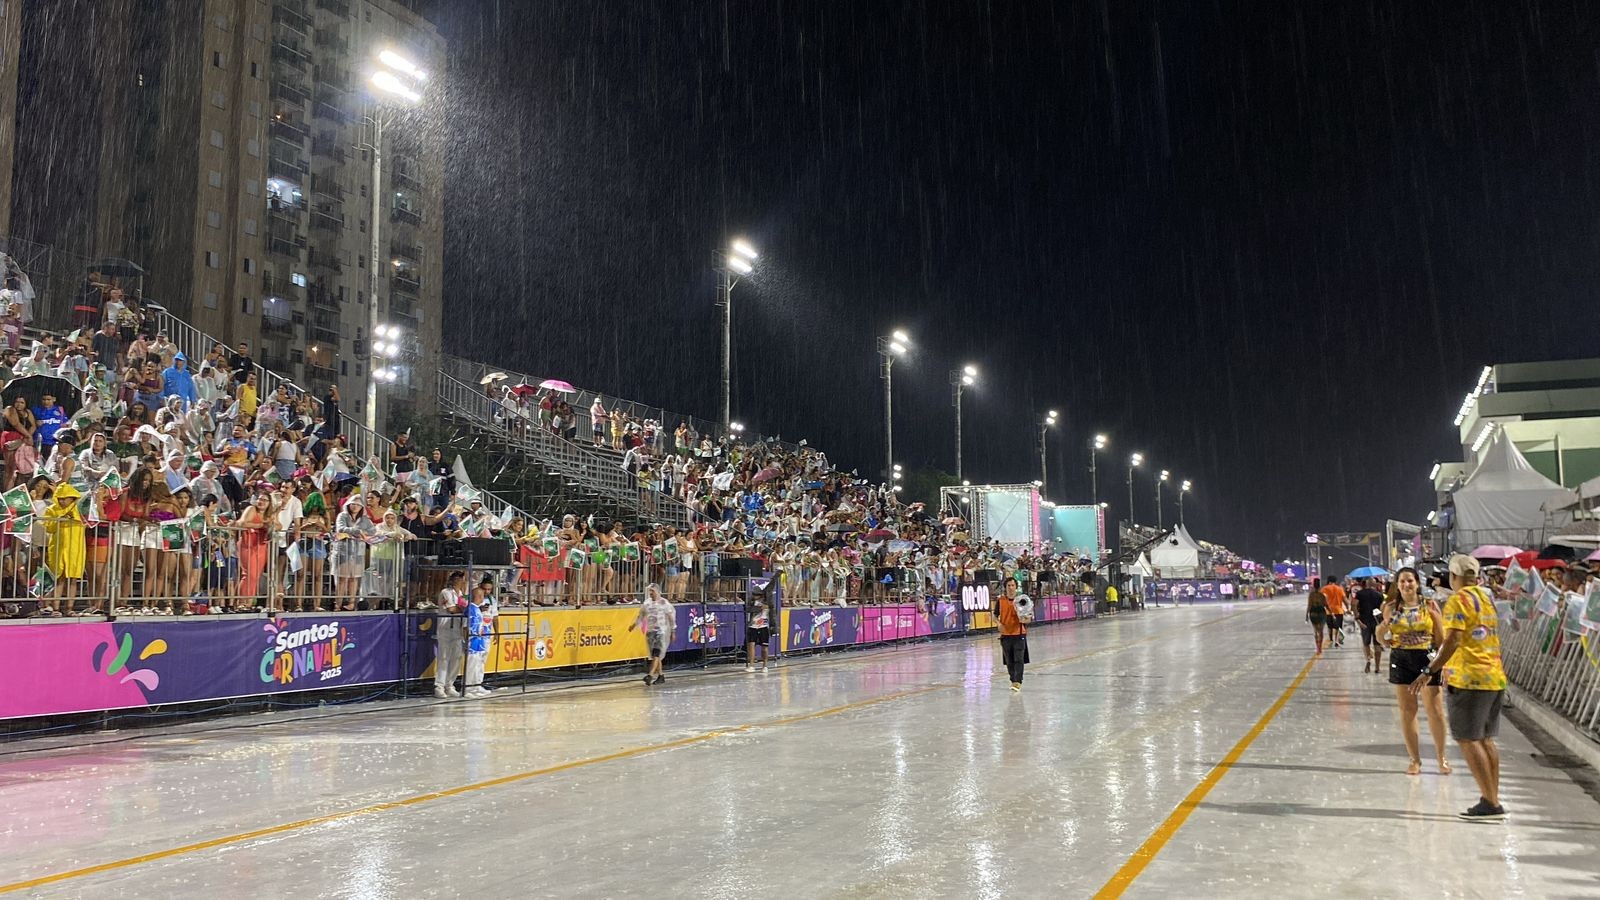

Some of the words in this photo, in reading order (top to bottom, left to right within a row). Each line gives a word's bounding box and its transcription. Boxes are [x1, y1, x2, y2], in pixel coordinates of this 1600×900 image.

[962, 585, 990, 611] 00:00
[275, 621, 339, 652] Santos
[579, 633, 612, 647] Santos
[260, 638, 342, 684] CARNAVAL
[320, 666, 342, 680] 2025
